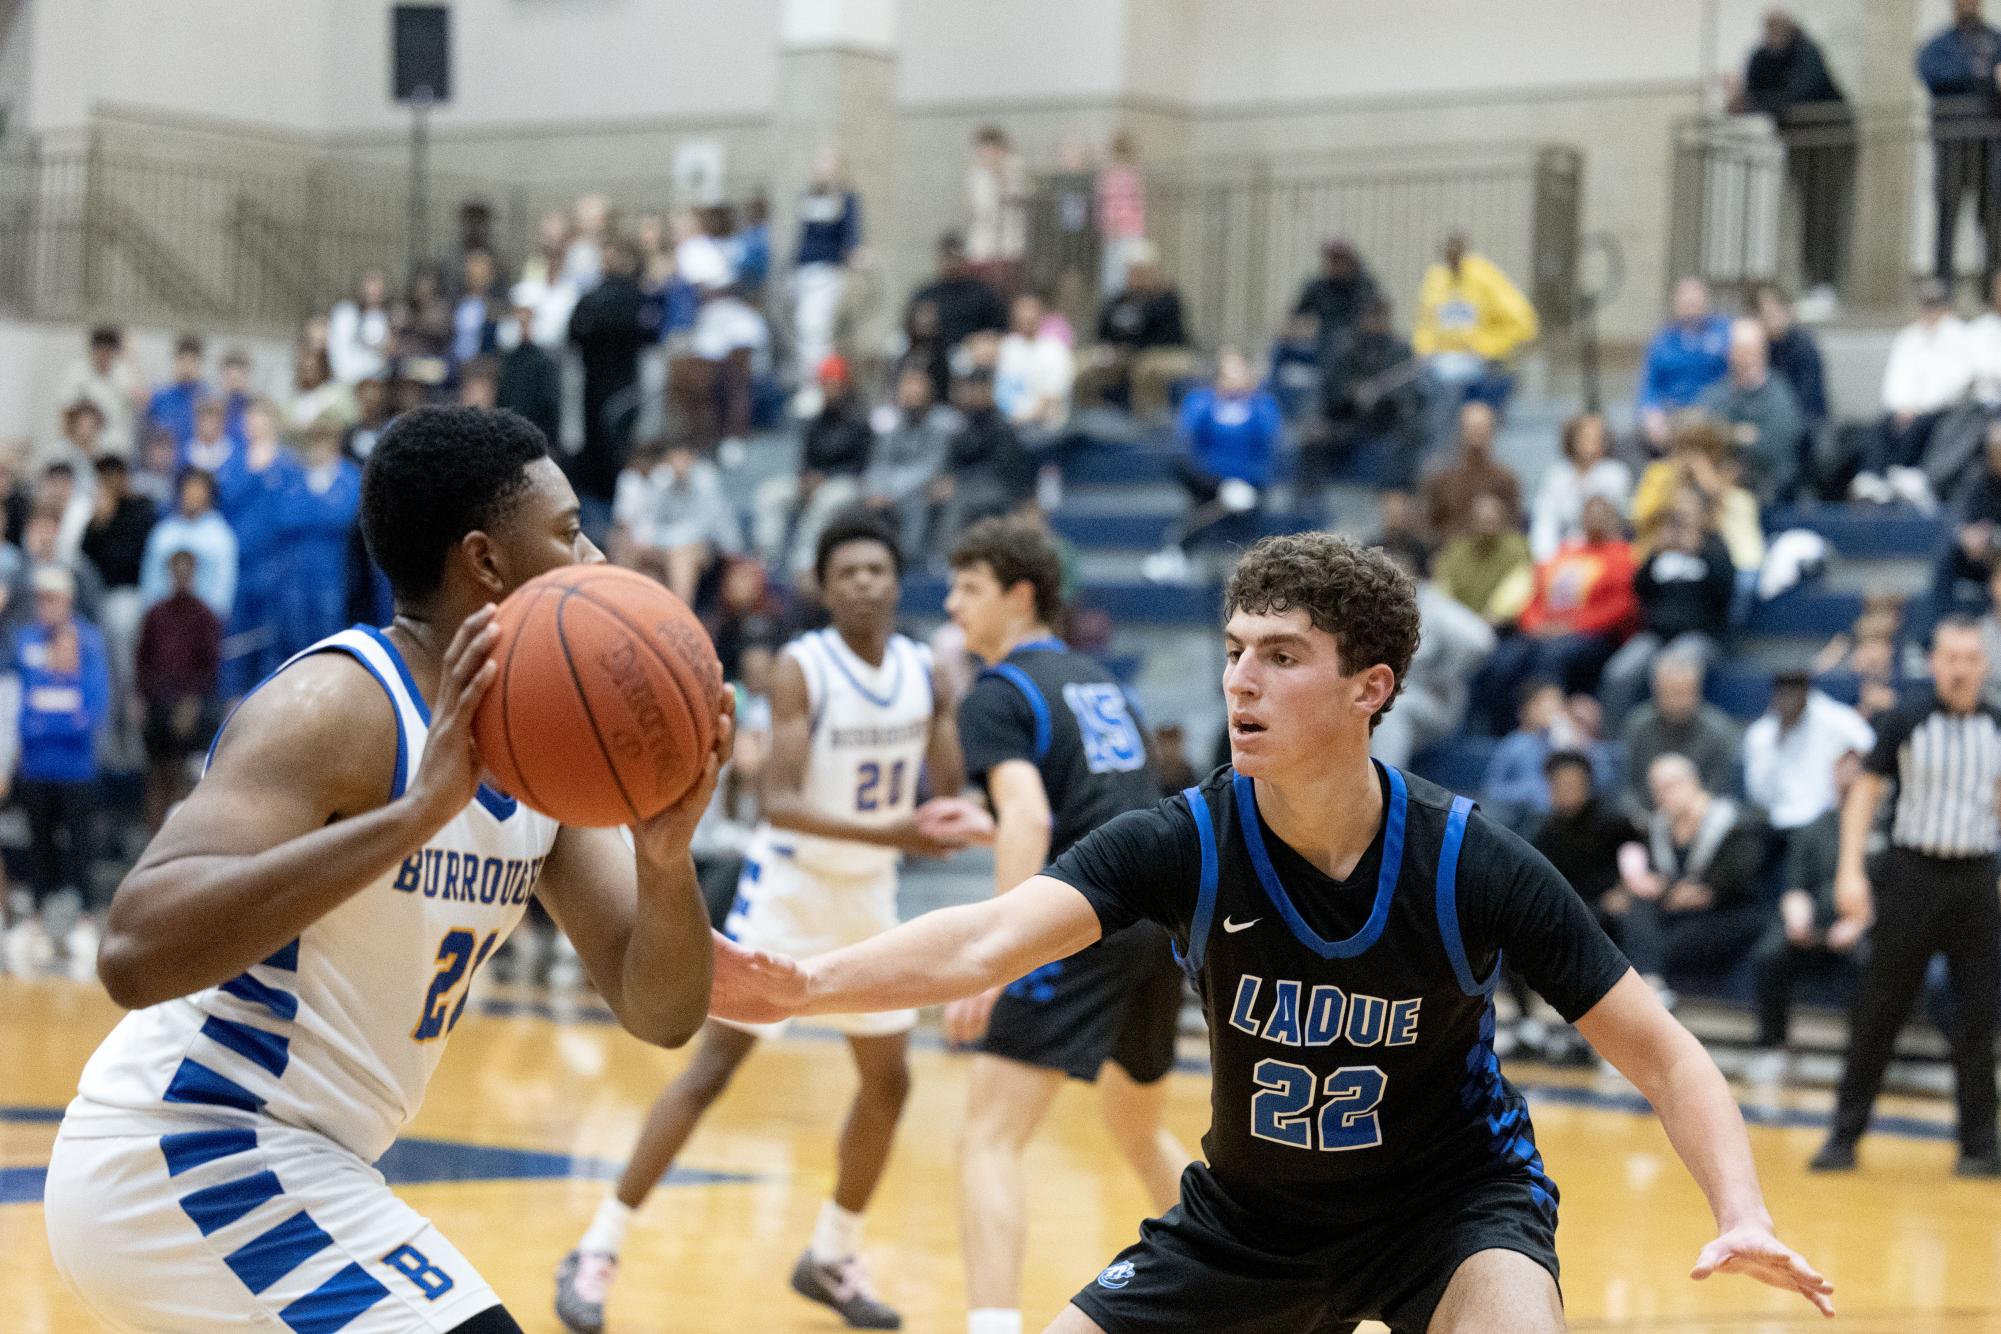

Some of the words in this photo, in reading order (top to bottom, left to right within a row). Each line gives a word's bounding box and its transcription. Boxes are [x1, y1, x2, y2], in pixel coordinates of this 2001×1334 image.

[1229, 974, 1423, 1048] LADUE
[1251, 1057, 1389, 1152] 22
[377, 1242, 455, 1304] B
